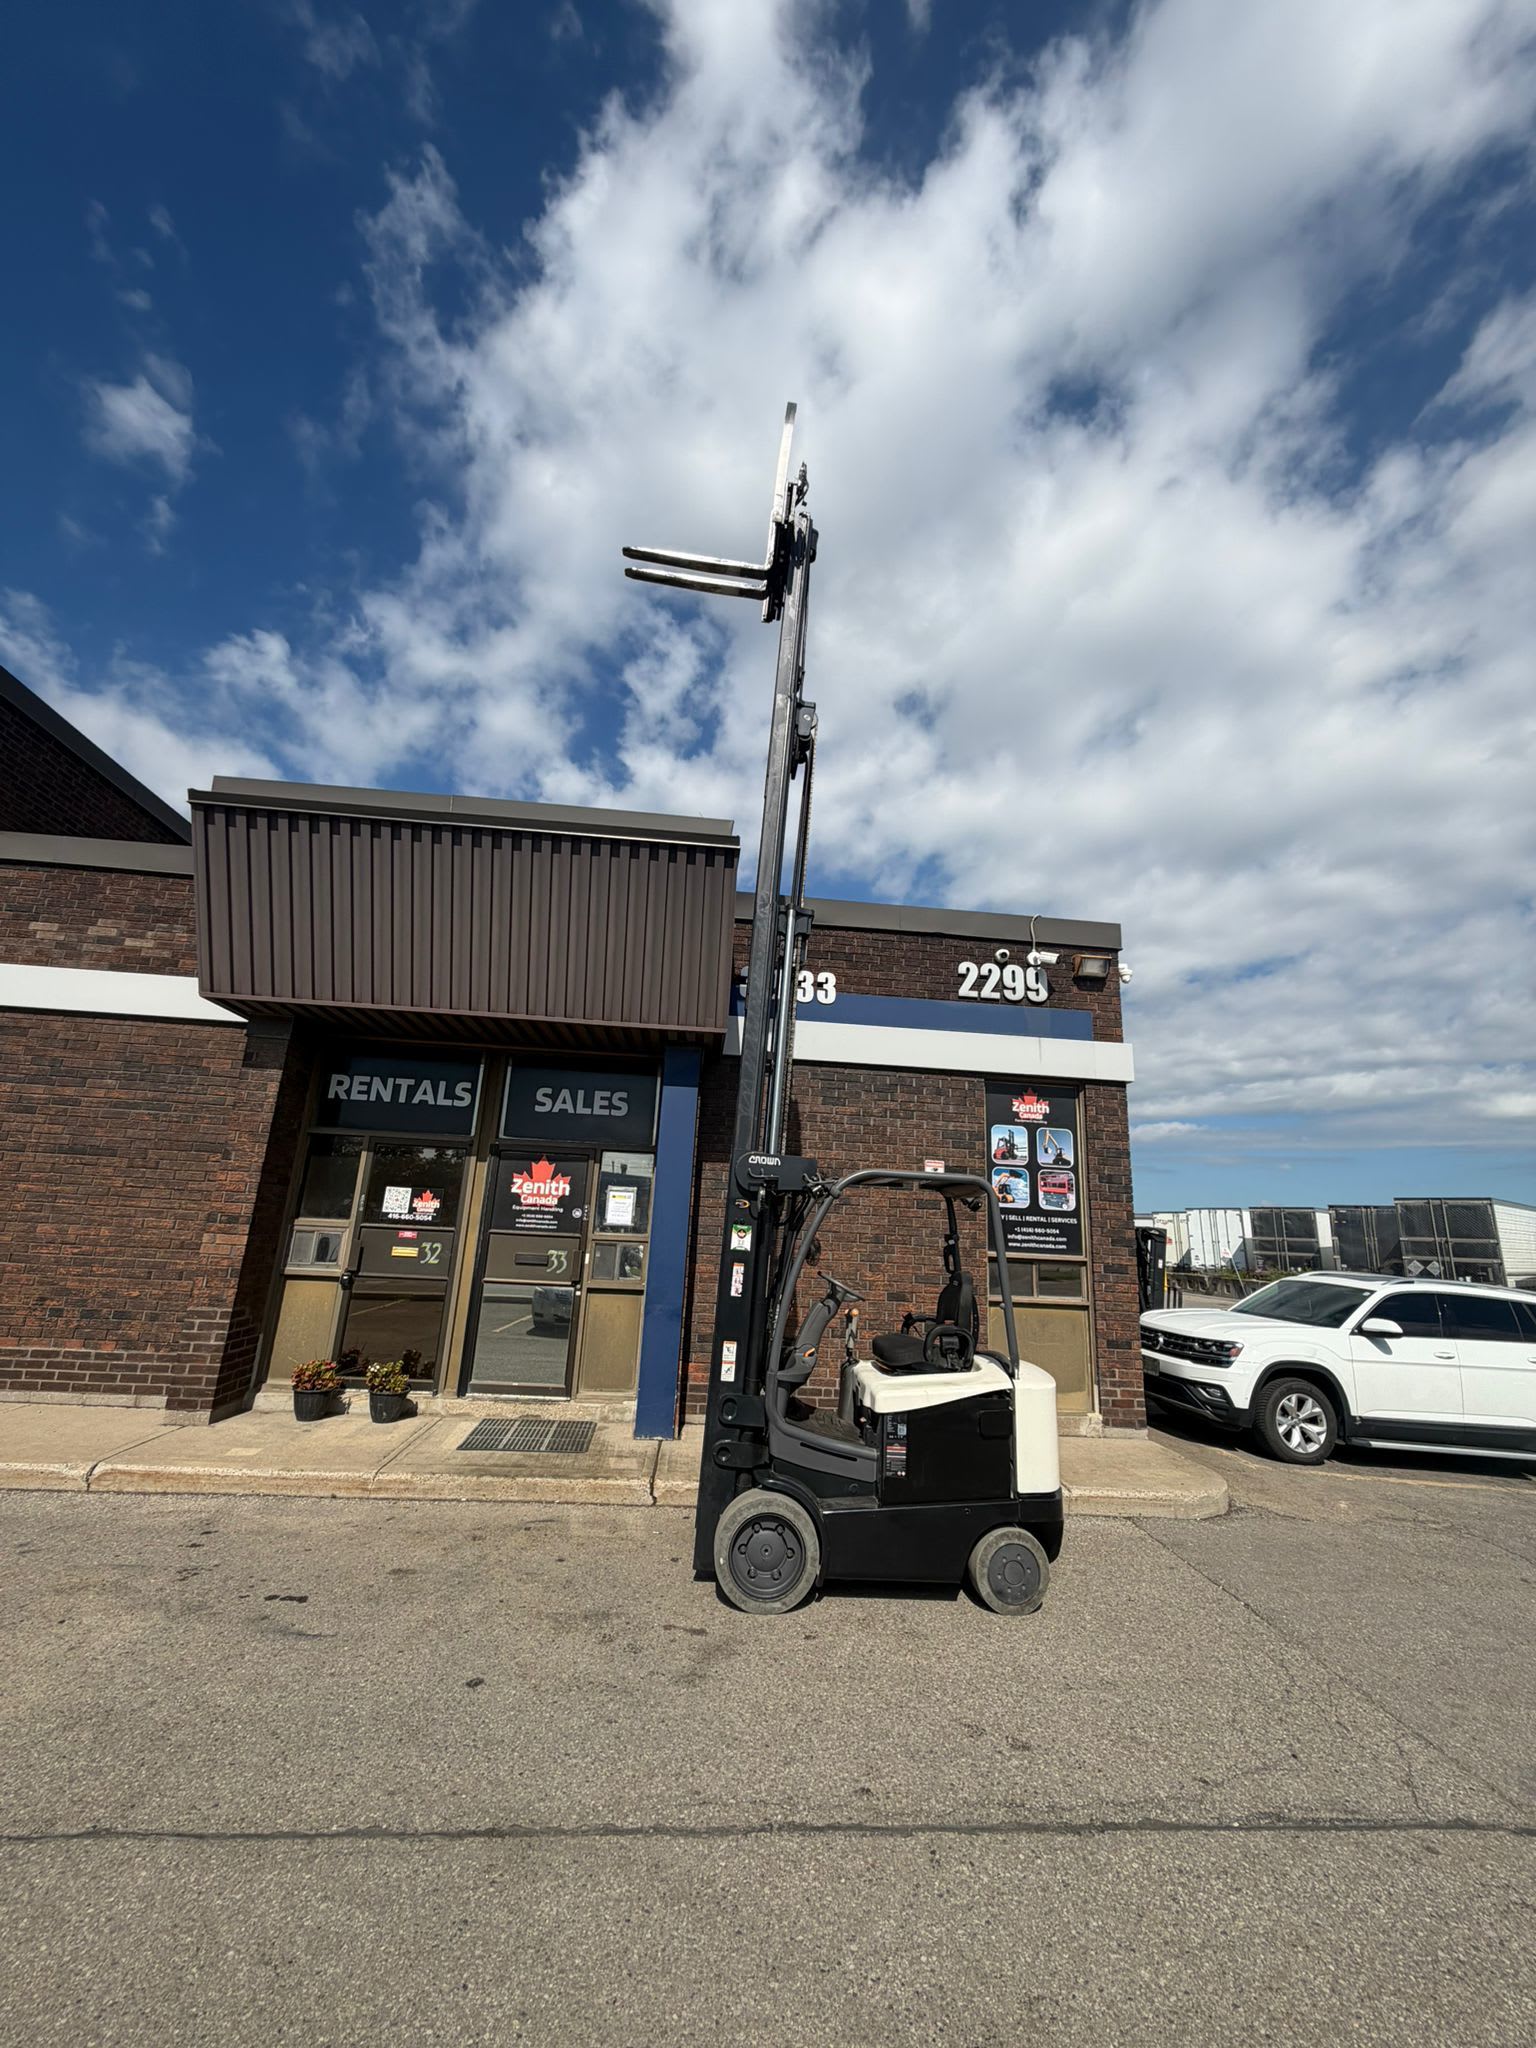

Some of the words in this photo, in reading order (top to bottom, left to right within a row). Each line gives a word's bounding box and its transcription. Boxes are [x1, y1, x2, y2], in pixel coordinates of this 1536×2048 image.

[958, 961, 1048, 1003] 2299
[328, 1074, 472, 1107] RENTALS
[535, 1087, 629, 1117] SALES
[1012, 1101, 1049, 1114] Zenith
[511, 1178, 570, 1196] Zenith
[521, 1194, 558, 1205] Canada
[1051, 1217, 1077, 1225] SERVICES
[420, 1242, 442, 1264] 32
[546, 1250, 567, 1274] 33
